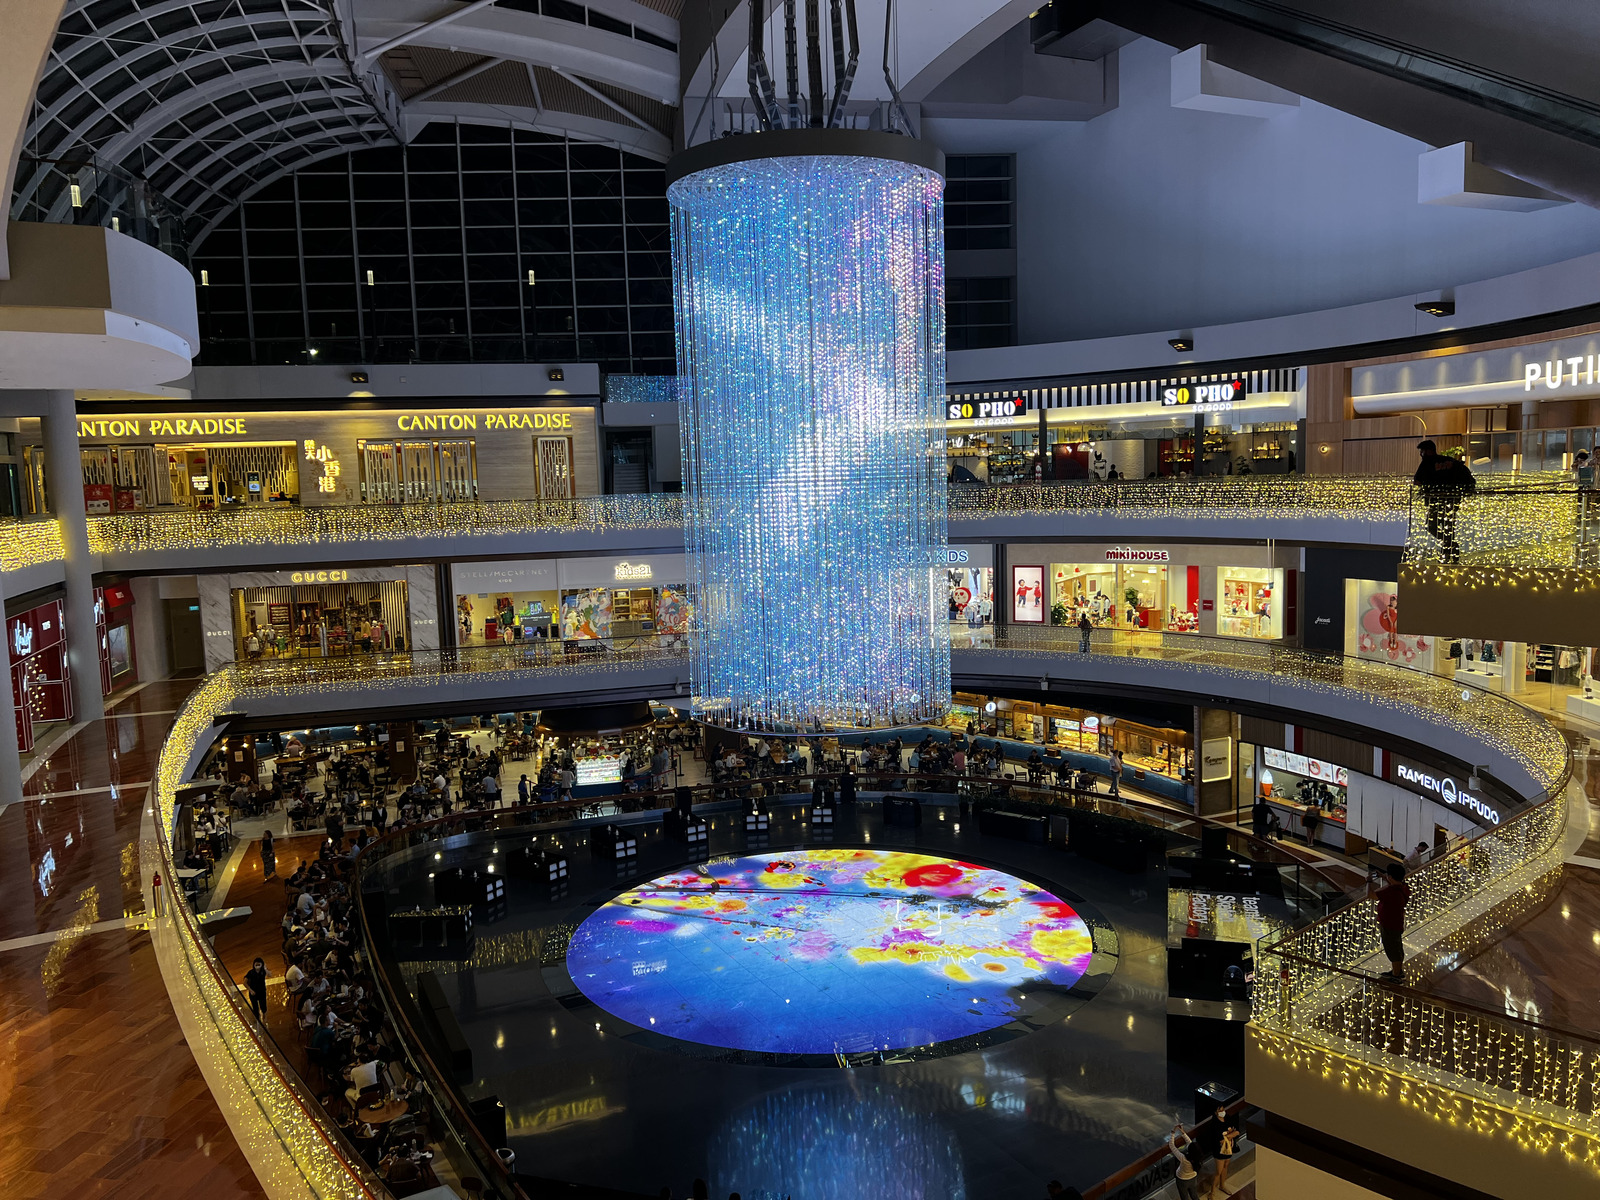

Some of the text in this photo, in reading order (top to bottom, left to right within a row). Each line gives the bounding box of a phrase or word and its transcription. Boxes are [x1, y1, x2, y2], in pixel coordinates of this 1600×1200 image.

[1525, 354, 1600, 391] PUTI
[1164, 383, 1234, 405] SO PHO
[949, 400, 1016, 419] SO PHO
[1192, 403, 1232, 413] SO GOOD
[77, 418, 247, 437] NTON PARADISE
[397, 413, 572, 431] CANTON PARADISE
[988, 417, 1014, 426] GOOD
[291, 570, 348, 583] GUCCI
[1397, 764, 1499, 825] RAMEN IPPUDO
[1189, 893, 1211, 924] Factory
